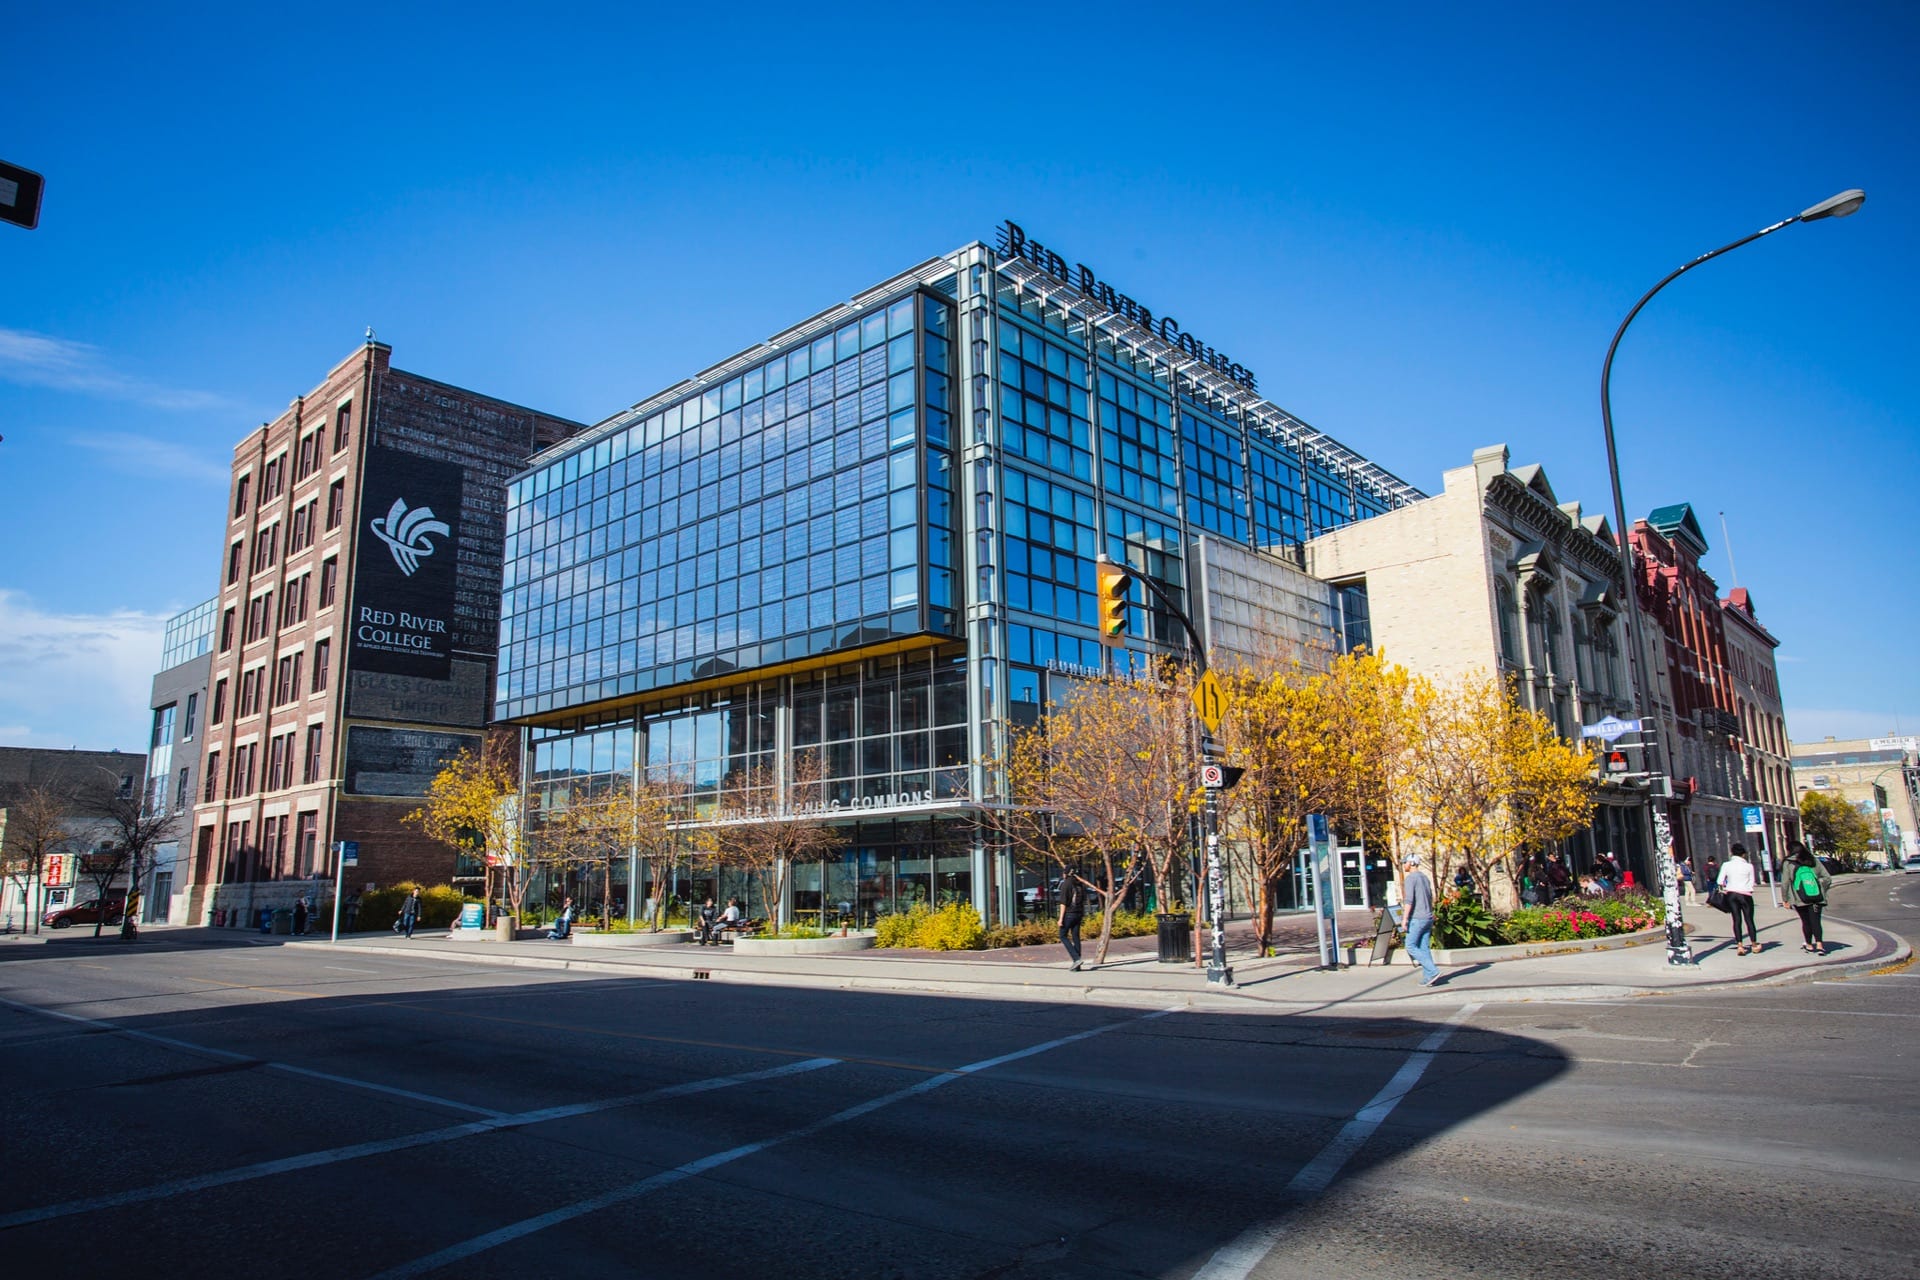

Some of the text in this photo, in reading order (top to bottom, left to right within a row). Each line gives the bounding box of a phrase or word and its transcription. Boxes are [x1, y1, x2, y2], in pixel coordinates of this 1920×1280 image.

[1003, 219, 1256, 391] RED RIVER COLLEGE
[359, 605, 396, 626] RED
[399, 612, 447, 634] RIVER
[357, 625, 432, 650] COLLEGE
[1586, 722, 1633, 735] WILLIAM
[851, 789, 933, 811] COMMONS
